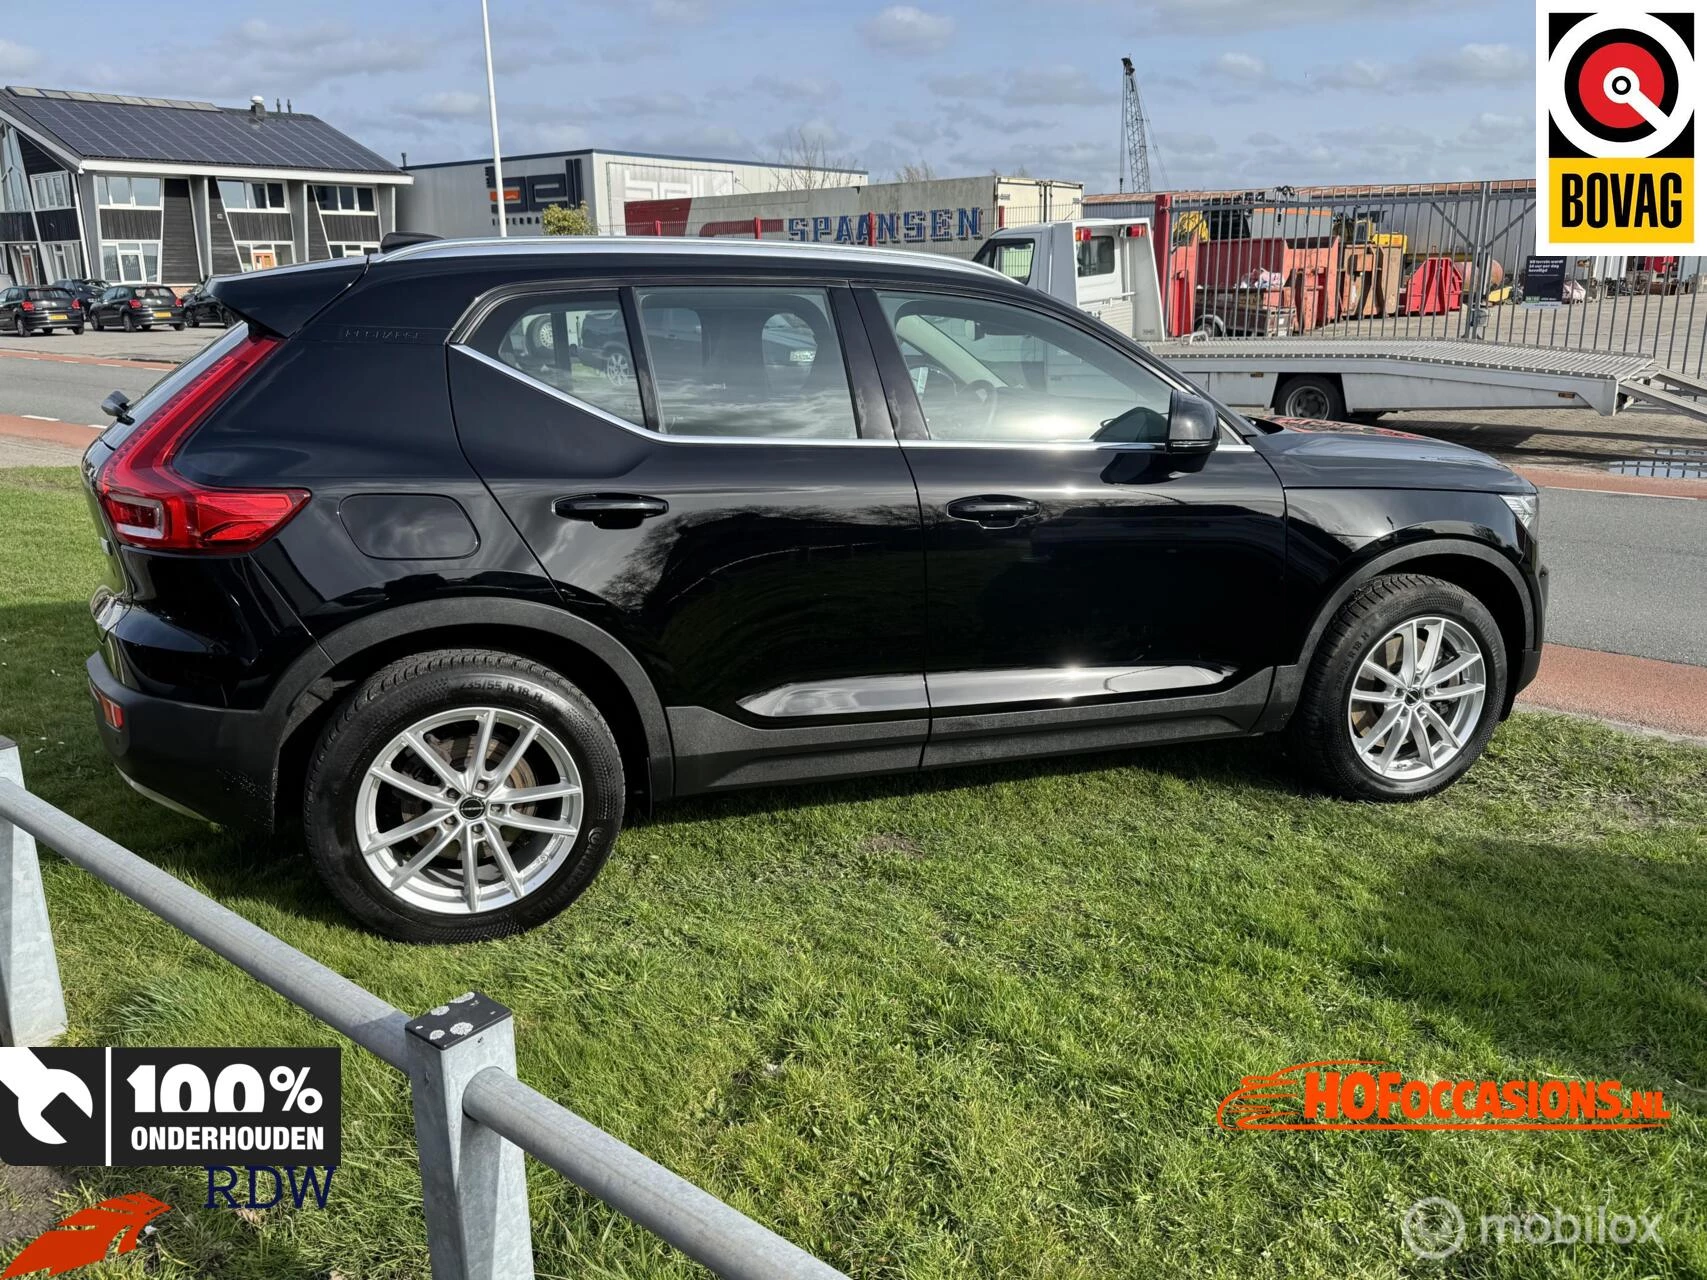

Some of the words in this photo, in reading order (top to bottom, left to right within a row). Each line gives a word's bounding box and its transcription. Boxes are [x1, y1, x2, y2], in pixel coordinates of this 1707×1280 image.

[788, 207, 984, 246] SPAANSEN
[506, 682, 514, 693] R
[517, 685, 530, 697] 18
